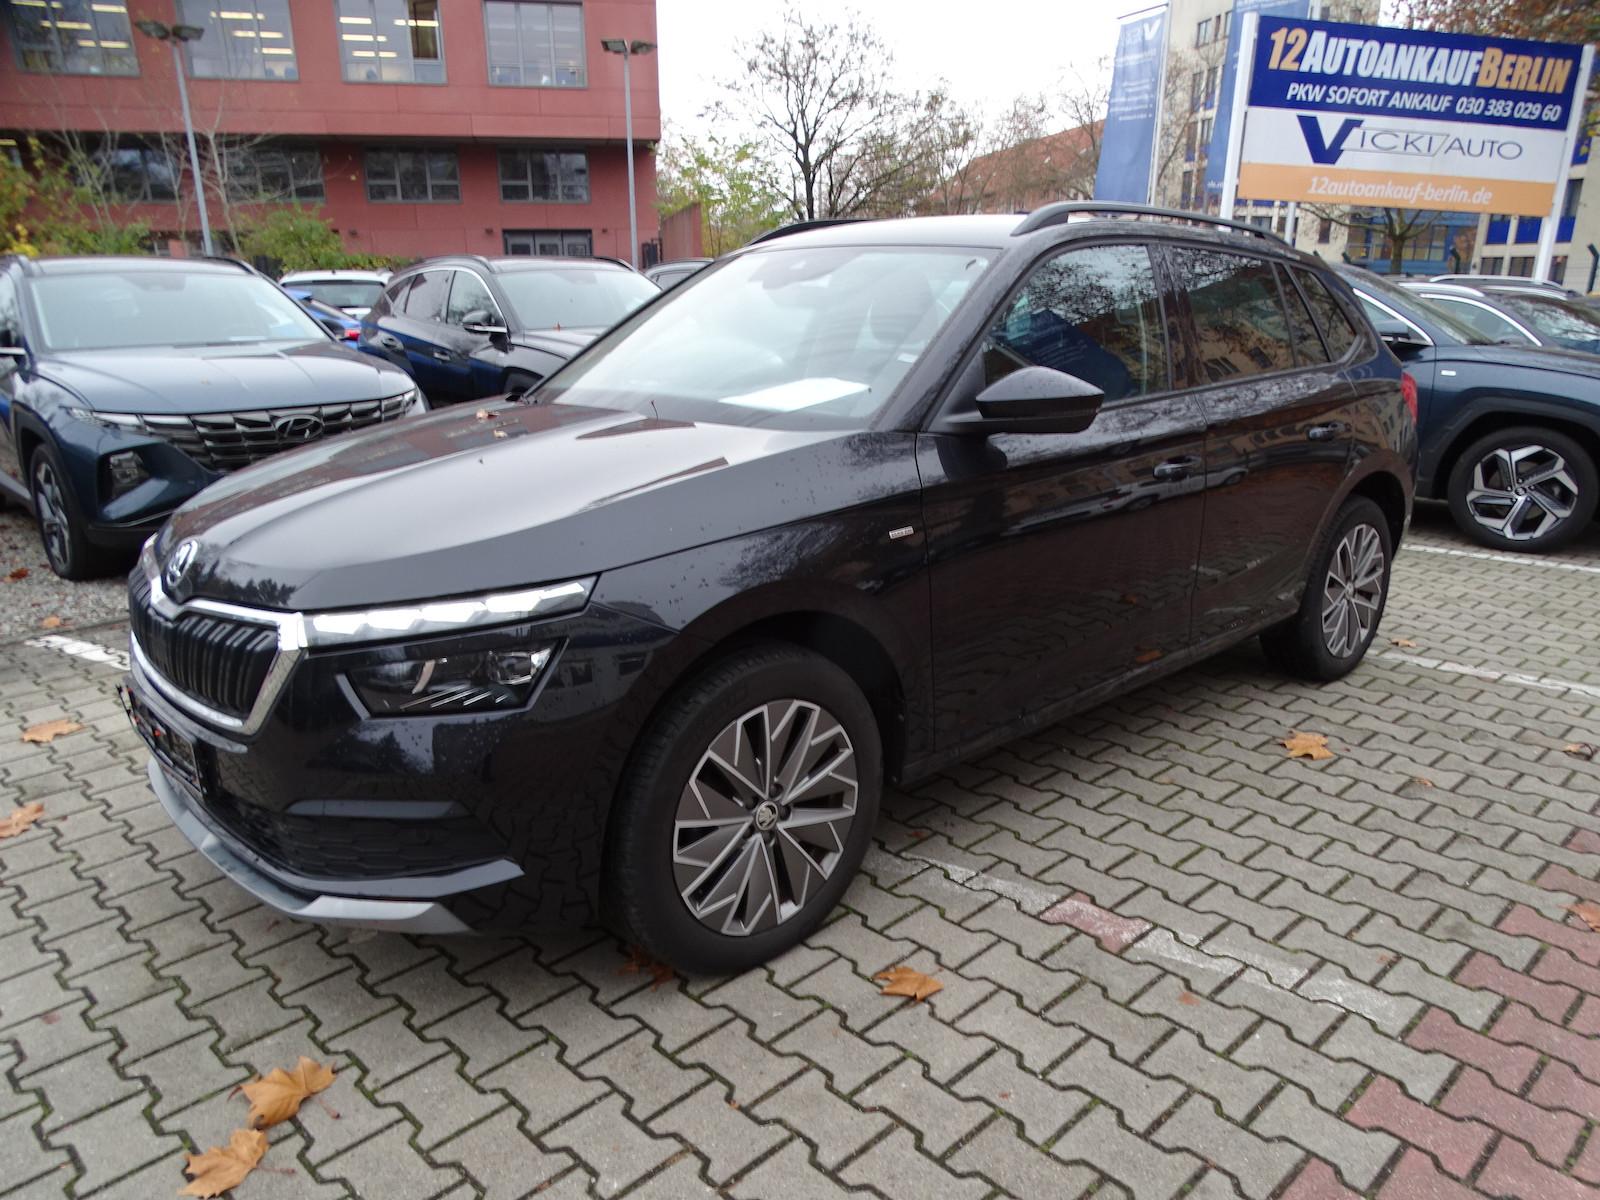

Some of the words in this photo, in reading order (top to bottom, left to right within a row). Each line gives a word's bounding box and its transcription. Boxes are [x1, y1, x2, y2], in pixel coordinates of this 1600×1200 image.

[1286, 82, 1326, 103] PKW
[1326, 85, 1390, 107] SOFORT
[1387, 91, 1453, 113] ANKAUF
[1455, 96, 1485, 115] 030
[1484, 98, 1514, 118] 383
[1513, 102, 1542, 120] 029
[1541, 104, 1562, 122] 60
[1307, 175, 1492, 205] 12autoankauf-berlin.de
